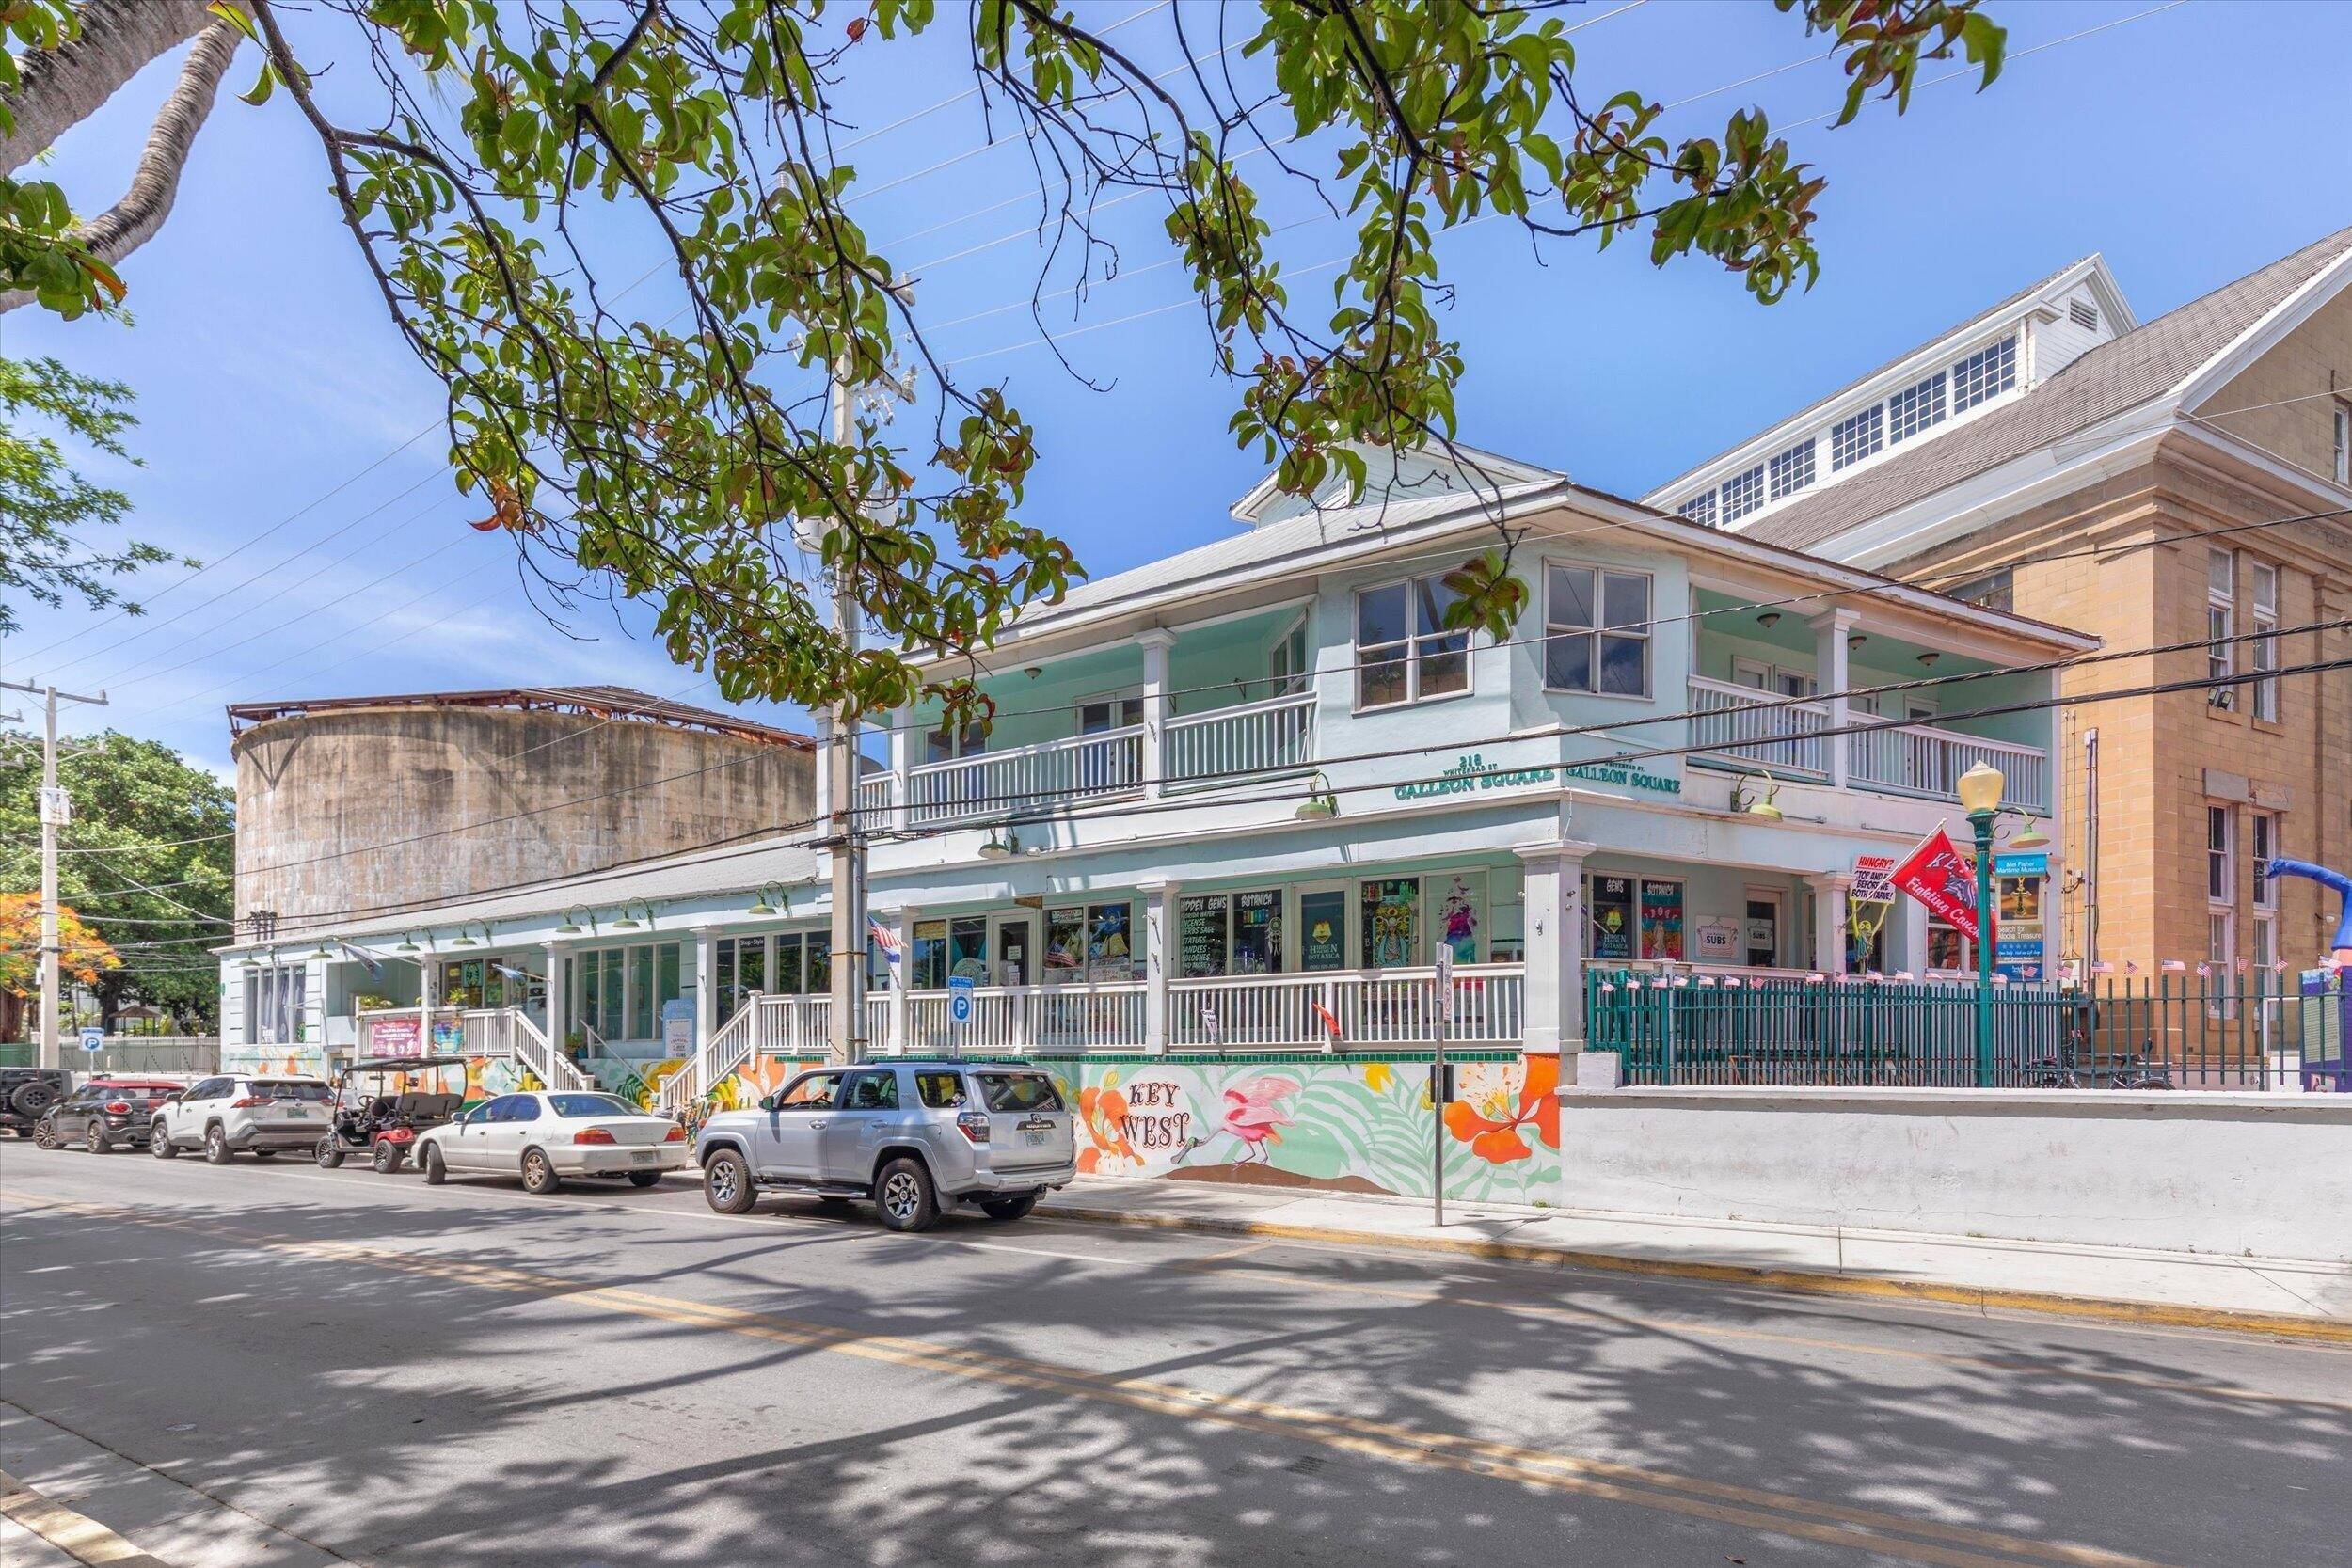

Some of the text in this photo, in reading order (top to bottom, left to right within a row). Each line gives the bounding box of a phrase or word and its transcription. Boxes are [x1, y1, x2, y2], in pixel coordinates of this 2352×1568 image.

[1394, 767, 1555, 800] GALLEON SQUARE
[1565, 766, 1680, 794] GALLEON SQUARE
[1858, 856, 1895, 869] HUNGRY?
[1241, 892, 1273, 908] BOTANICA
[1851, 889, 1868, 898] BOTH
[1906, 876, 1950, 913] Fighting
[1207, 896, 1227, 910] GEMS
[1706, 935, 1726, 945] SUBS
[957, 999, 967, 1016] P
[87, 1038, 97, 1048] P
[1129, 1082, 1181, 1108] KEY
[1119, 1112, 1191, 1150] WEST
